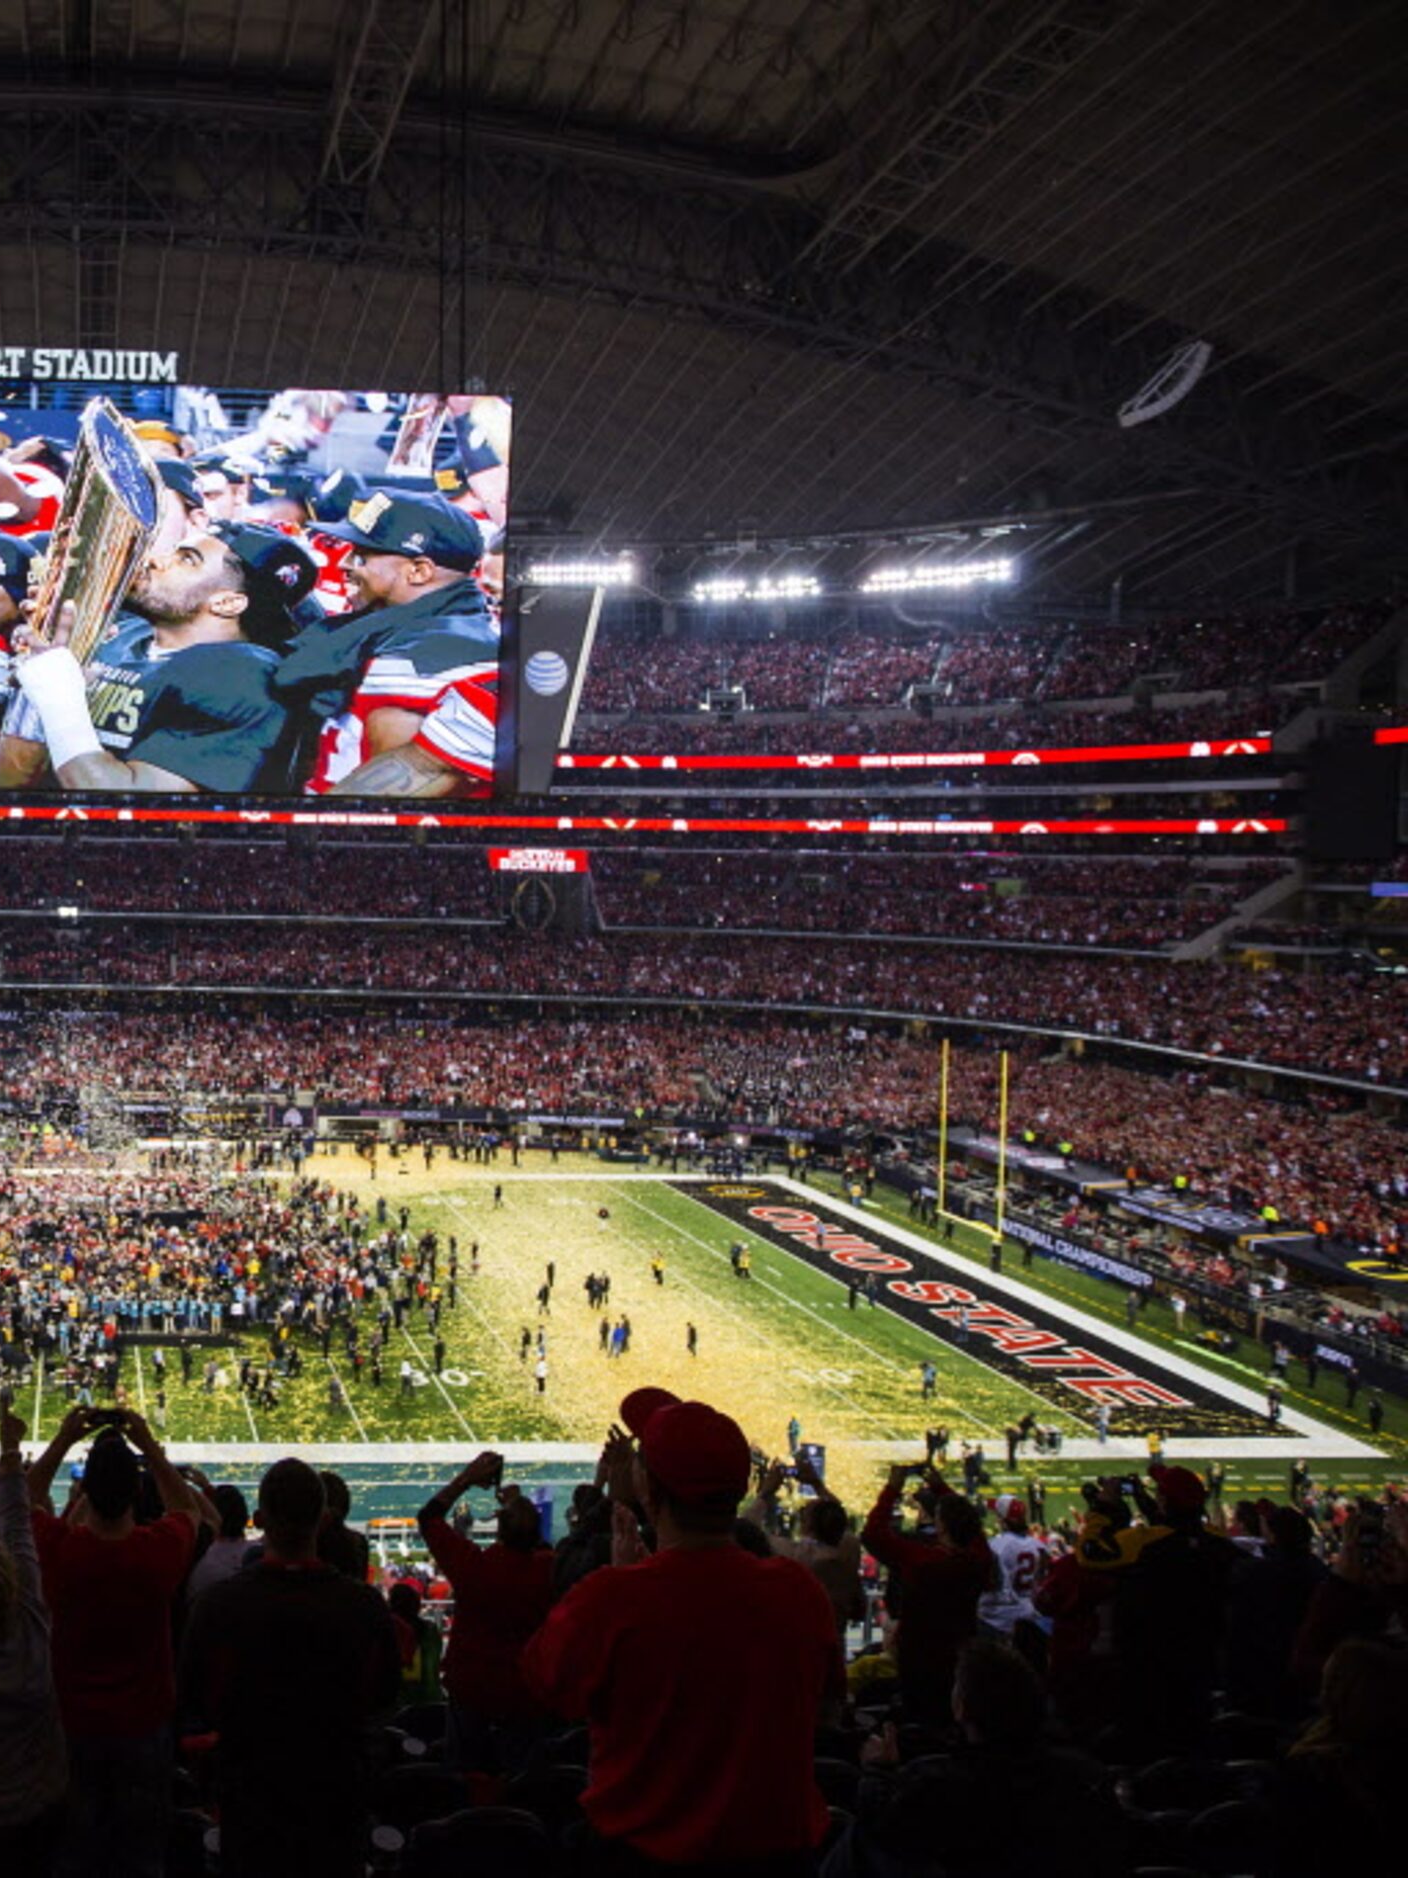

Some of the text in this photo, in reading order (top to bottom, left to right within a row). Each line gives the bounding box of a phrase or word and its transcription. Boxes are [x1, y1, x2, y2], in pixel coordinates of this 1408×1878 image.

[32, 348, 179, 382] STADIUM
[748, 1206, 913, 1273] OHIO
[887, 1280, 1195, 1407] STATE
